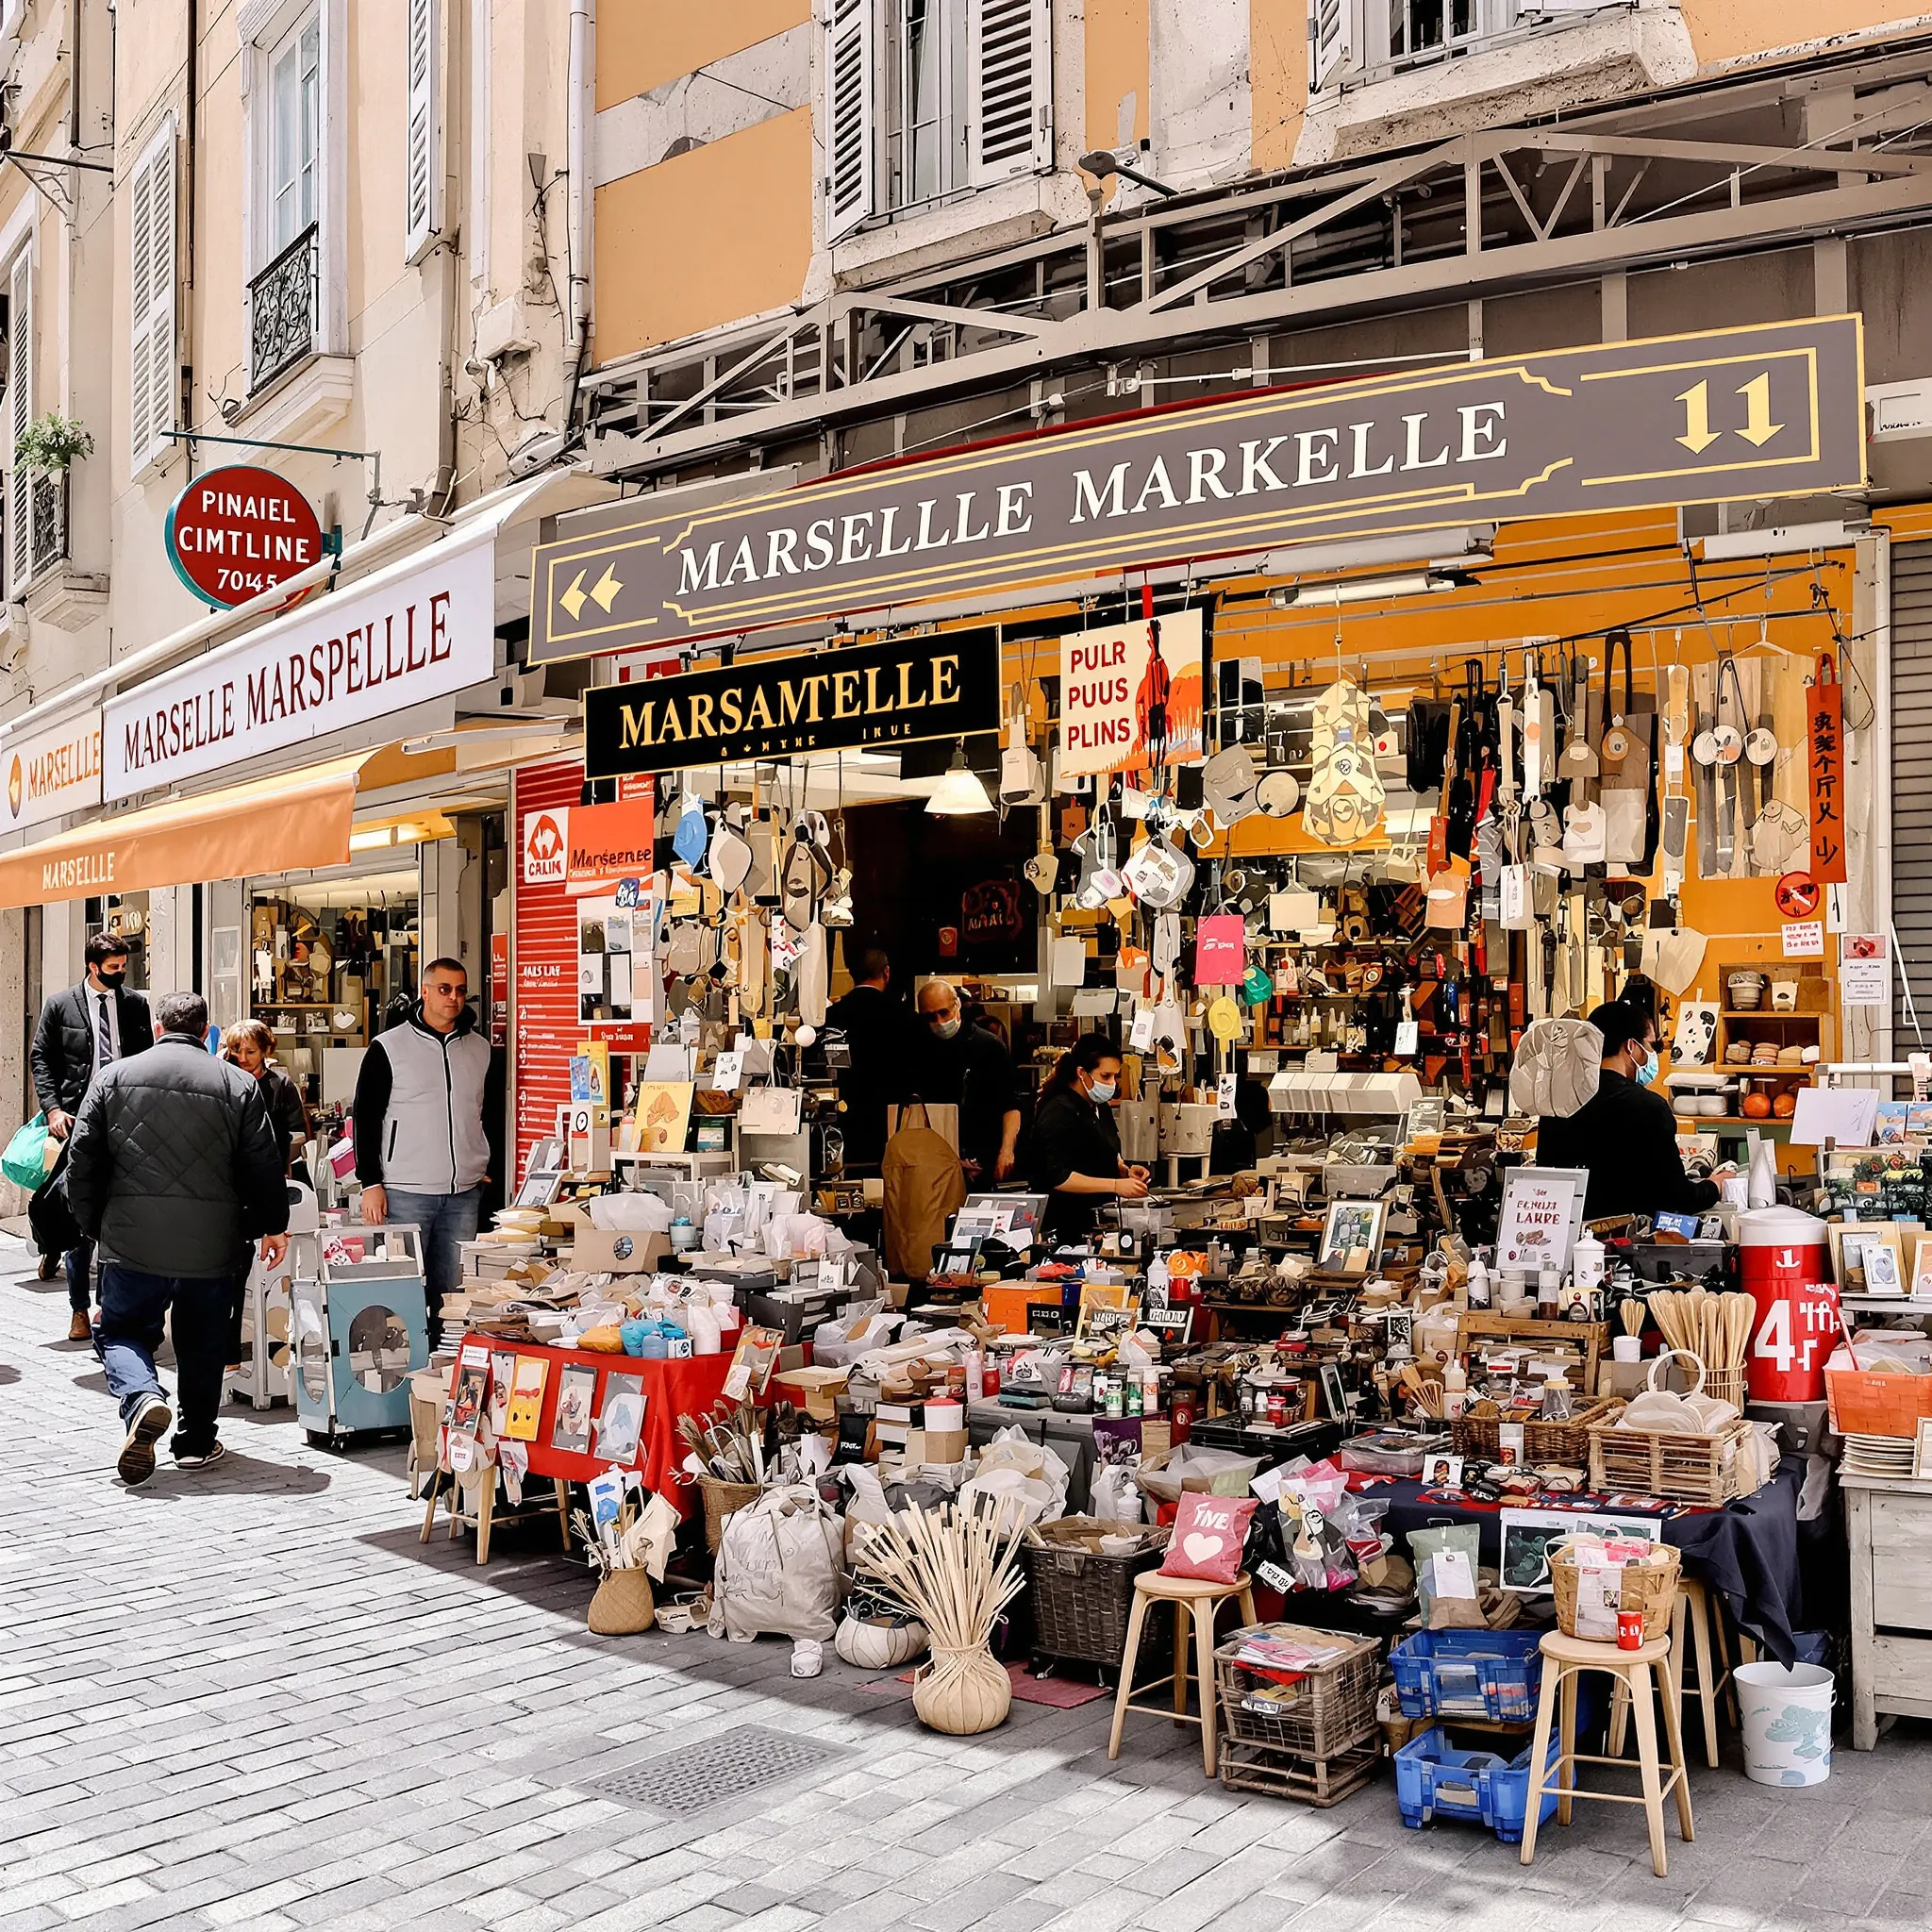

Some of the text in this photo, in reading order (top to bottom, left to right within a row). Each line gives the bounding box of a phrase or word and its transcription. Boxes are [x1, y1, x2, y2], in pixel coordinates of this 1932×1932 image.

[201, 490, 296, 524] PINAIEL
[675, 400, 1508, 596] MARSELLLE MARKELLE
[178, 525, 310, 564] CIMTLINE
[1070, 641, 1126, 674] PULR
[123, 590, 453, 774] MARSELLE MARSPELLLE
[1068, 677, 1129, 709] PUUS
[1067, 717, 1131, 751] PLINS
